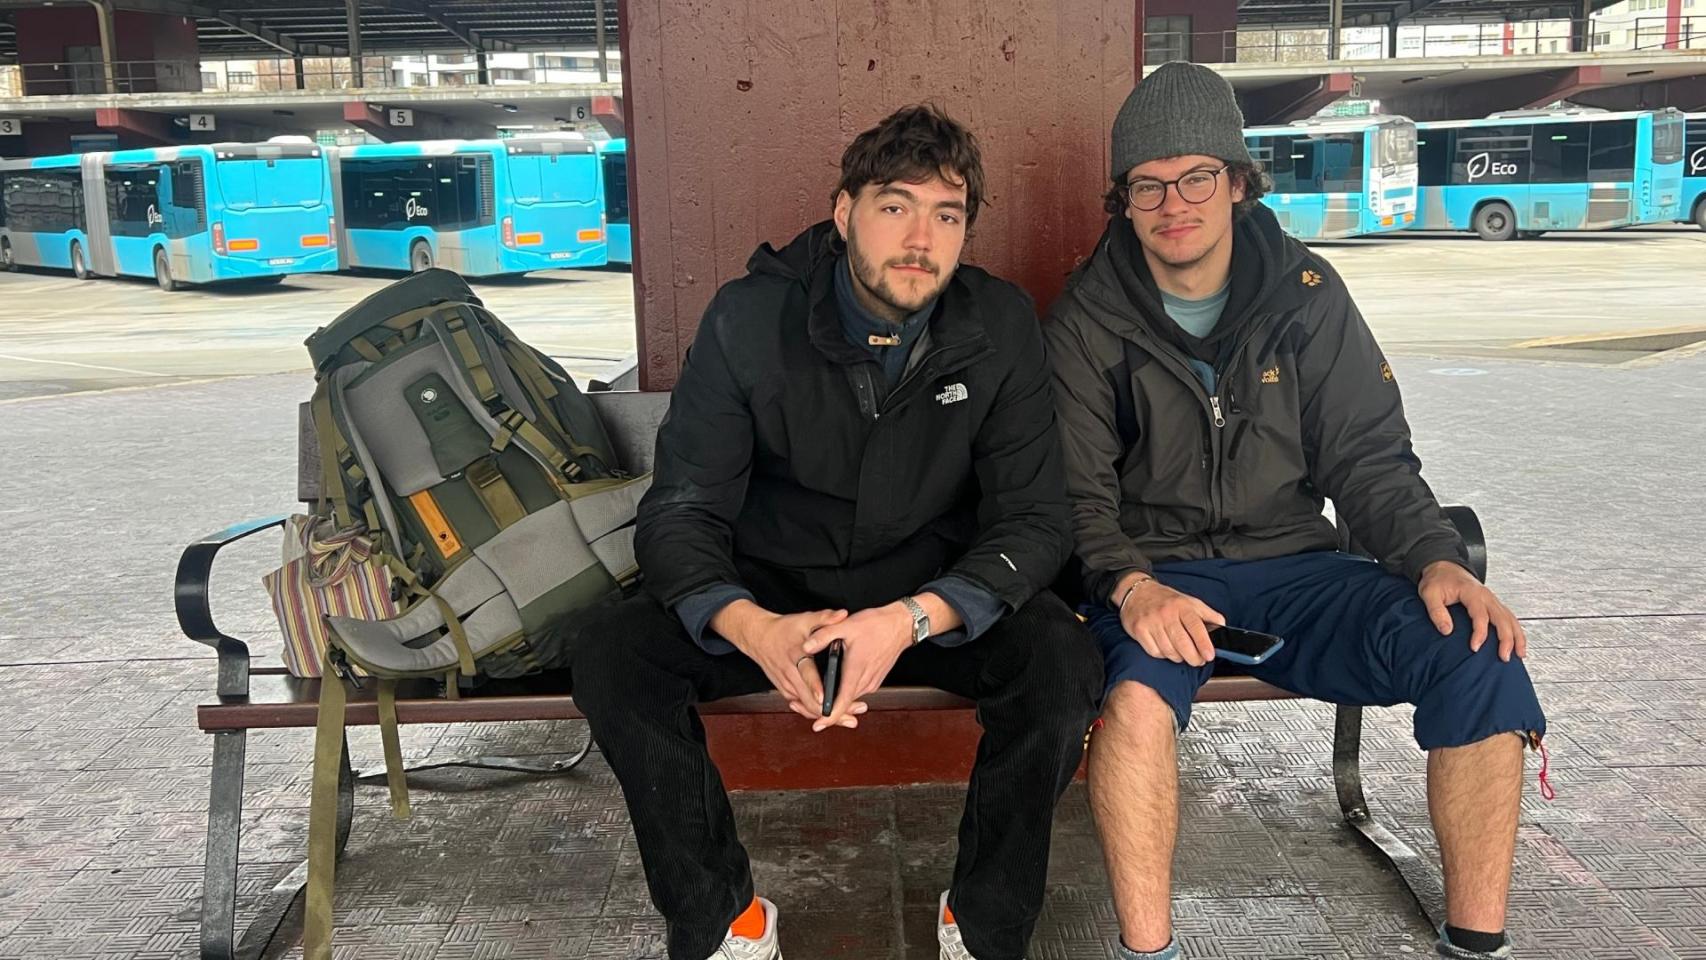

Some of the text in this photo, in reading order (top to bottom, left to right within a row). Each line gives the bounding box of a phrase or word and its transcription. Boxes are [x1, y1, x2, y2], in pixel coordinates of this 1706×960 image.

[397, 111, 406, 124] 5
[576, 106, 585, 120] 6
[2, 120, 12, 133] 3
[198, 115, 208, 128] 4
[944, 384, 956, 392] THE
[935, 390, 957, 401] NORTH
[942, 395, 957, 406] FACE
